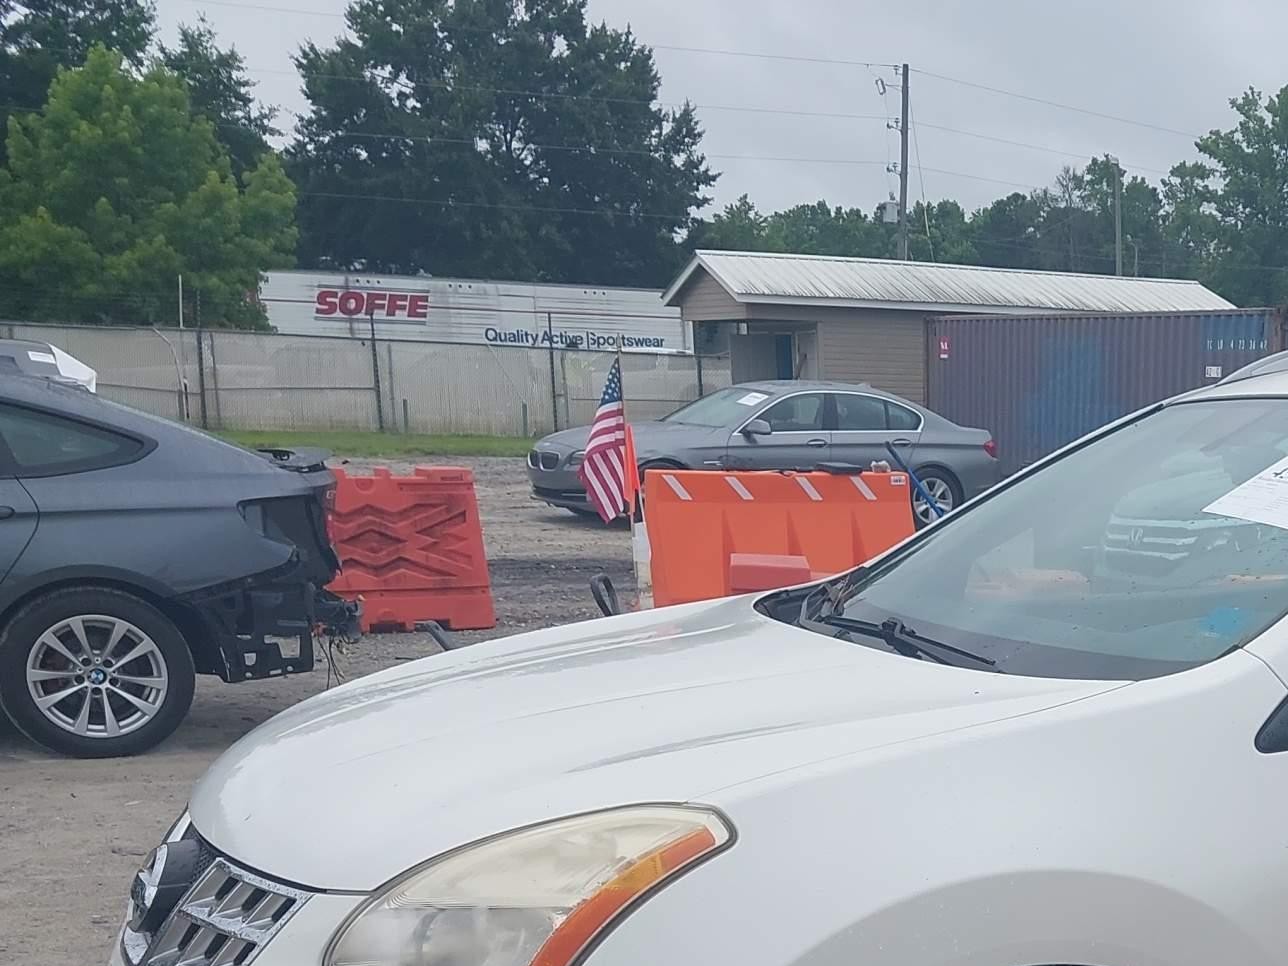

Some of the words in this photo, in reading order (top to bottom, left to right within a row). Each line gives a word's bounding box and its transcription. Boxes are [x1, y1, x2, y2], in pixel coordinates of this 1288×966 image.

[315, 290, 429, 318] SOFFE
[484, 327, 539, 346] Quality
[540, 330, 584, 346] Active
